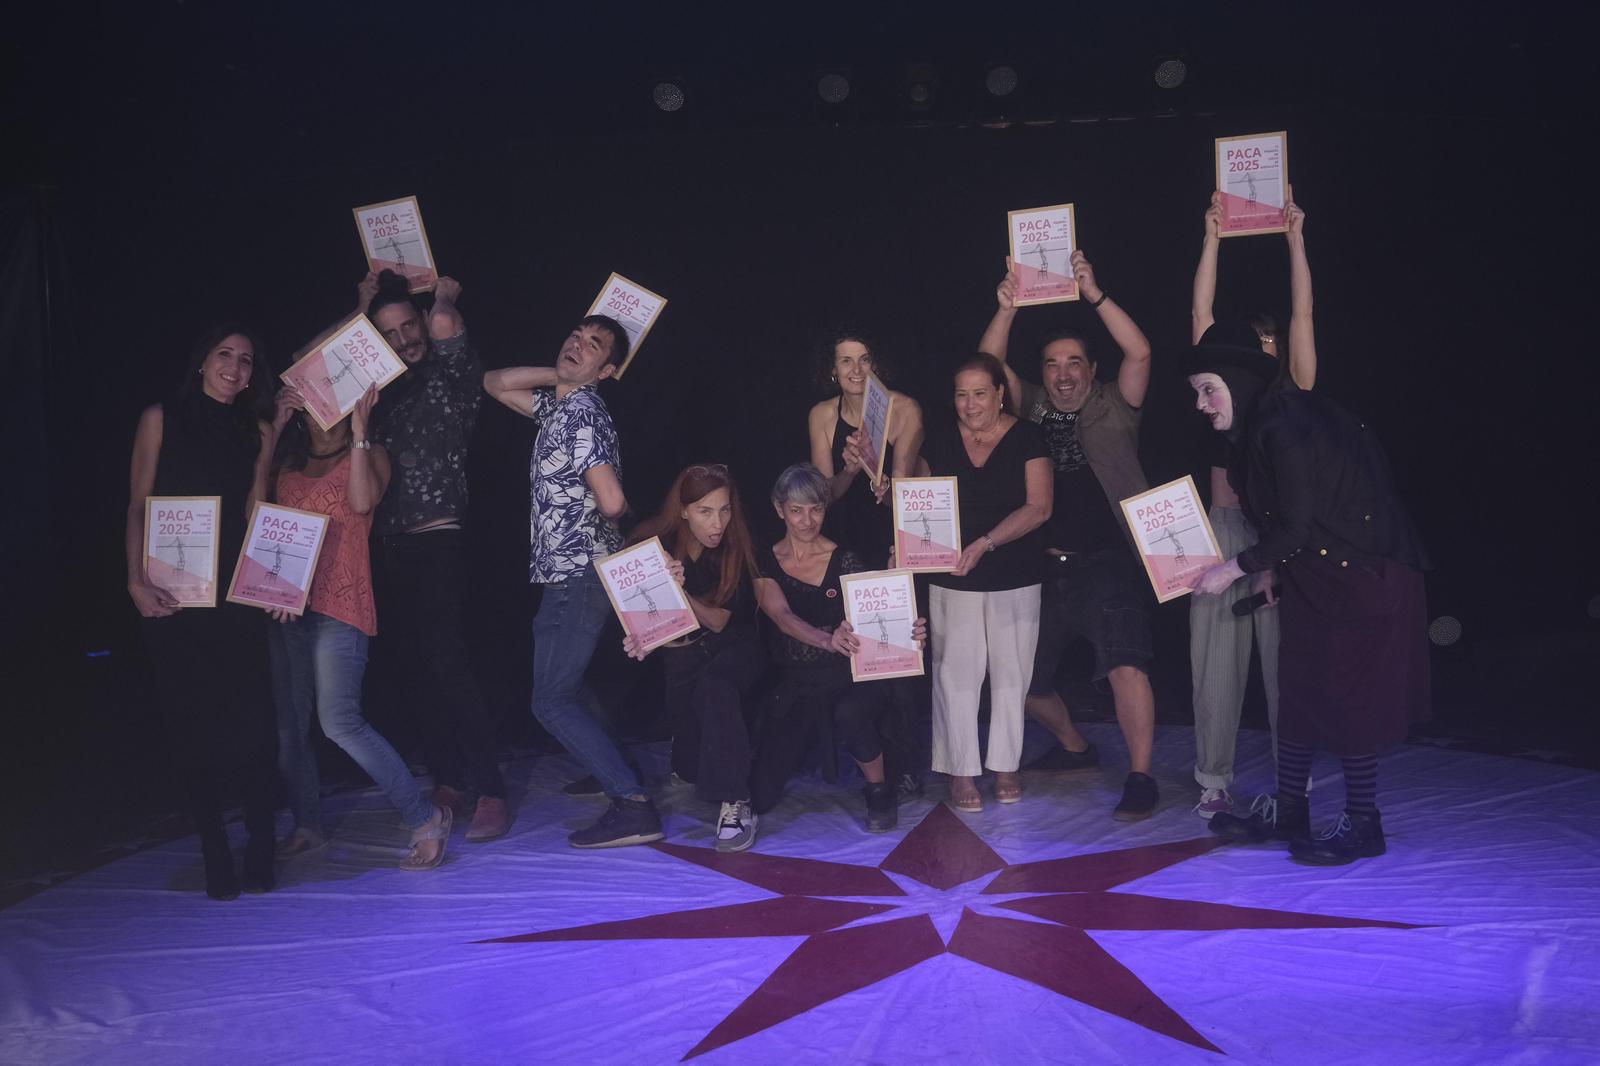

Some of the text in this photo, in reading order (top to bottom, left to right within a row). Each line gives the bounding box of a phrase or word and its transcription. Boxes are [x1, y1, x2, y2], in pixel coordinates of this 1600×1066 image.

[1227, 148, 1261, 160] PACA
[1229, 160, 1259, 172] 2025
[367, 213, 399, 227] PACA
[1019, 219, 1051, 232] PACA
[372, 225, 399, 238] 2025
[1022, 232, 1049, 243] 2025
[612, 288, 639, 308] PACA
[607, 298, 634, 316] 2025
[352, 330, 379, 362] PACA
[344, 340, 368, 367] 2025
[903, 490, 934, 499] PACA
[905, 502, 932, 511] 2025
[1136, 500, 1174, 520] PACA
[158, 510, 193, 521] PACA
[1144, 512, 1175, 532] 2025
[159, 524, 190, 534] 2025
[262, 516, 298, 532] PACA
[260, 529, 293, 543] 2025
[610, 559, 643, 579] PACA
[617, 571, 646, 590] 2025
[855, 587, 889, 600] PACA
[858, 600, 888, 612] 2025
